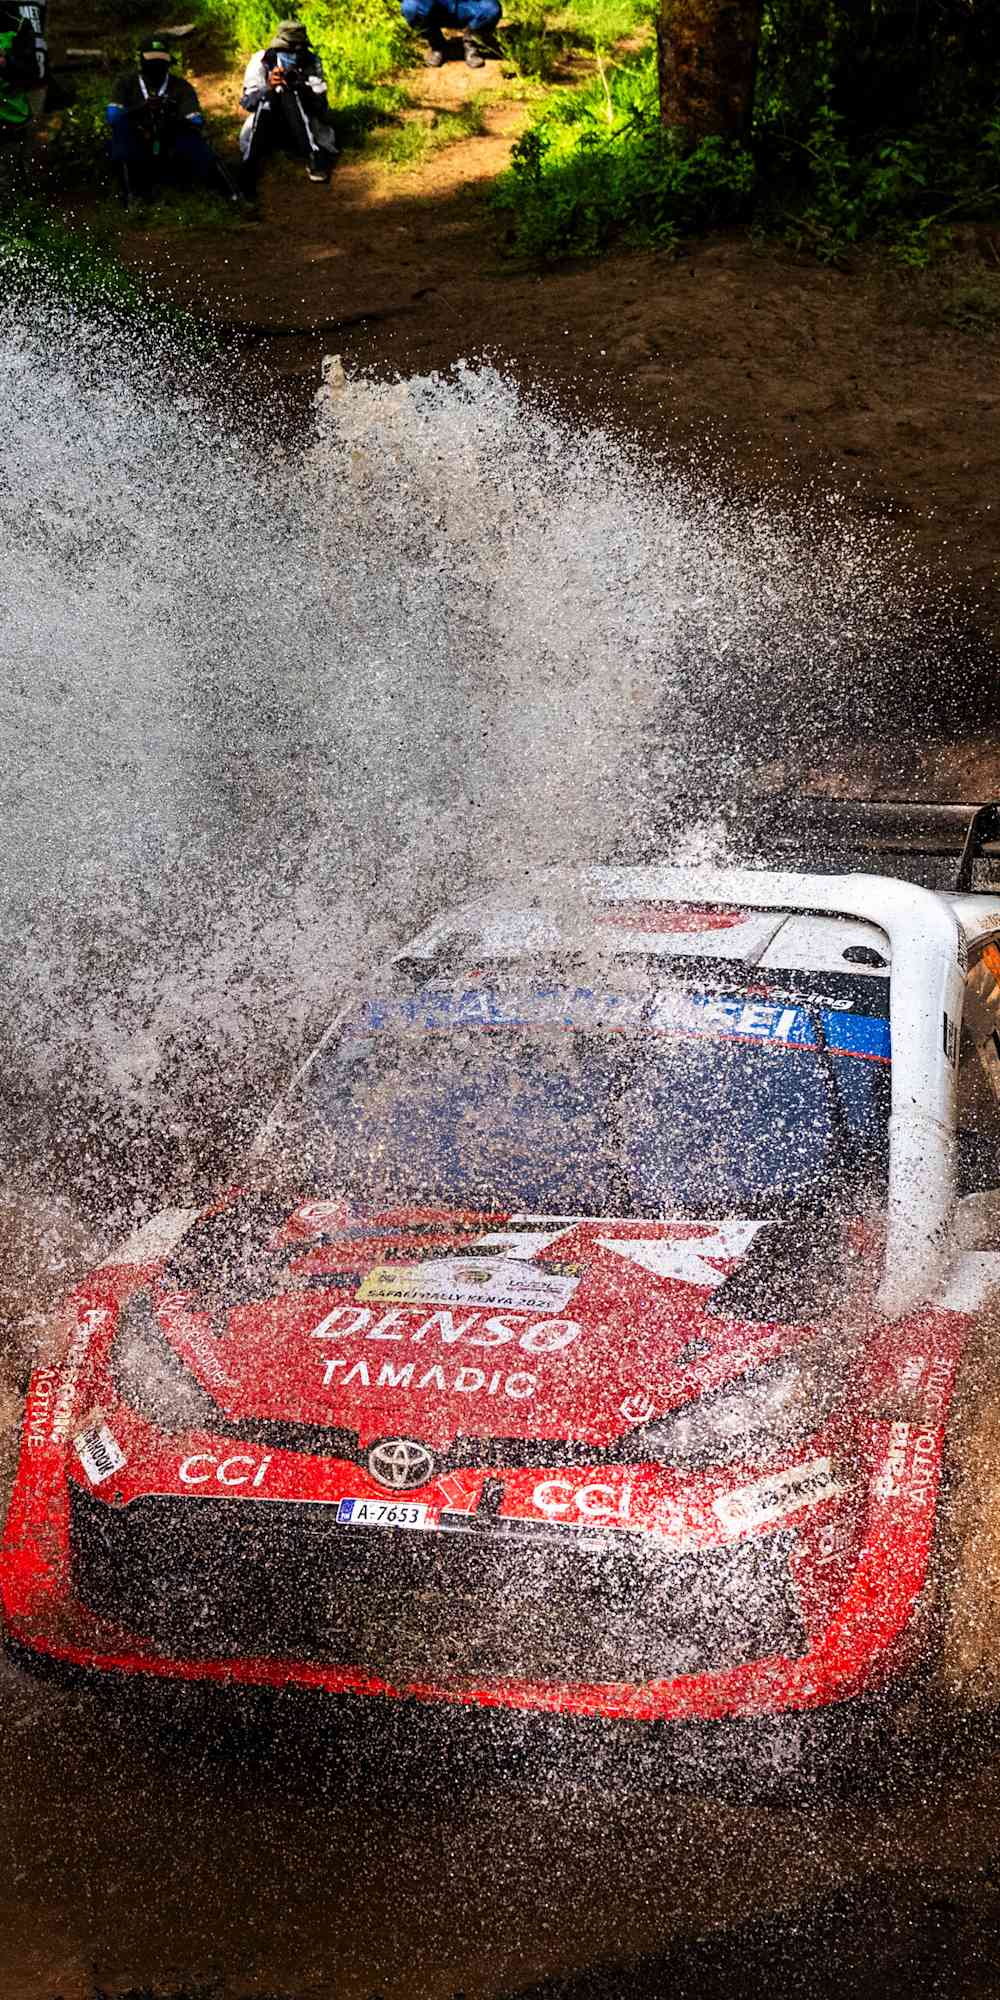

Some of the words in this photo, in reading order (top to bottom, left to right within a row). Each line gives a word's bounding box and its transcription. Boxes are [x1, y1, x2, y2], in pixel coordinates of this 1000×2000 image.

[311, 1306, 583, 1353] DENSO
[321, 1358, 538, 1400] TAMADIC
[357, 1504, 419, 1524] A-7653
